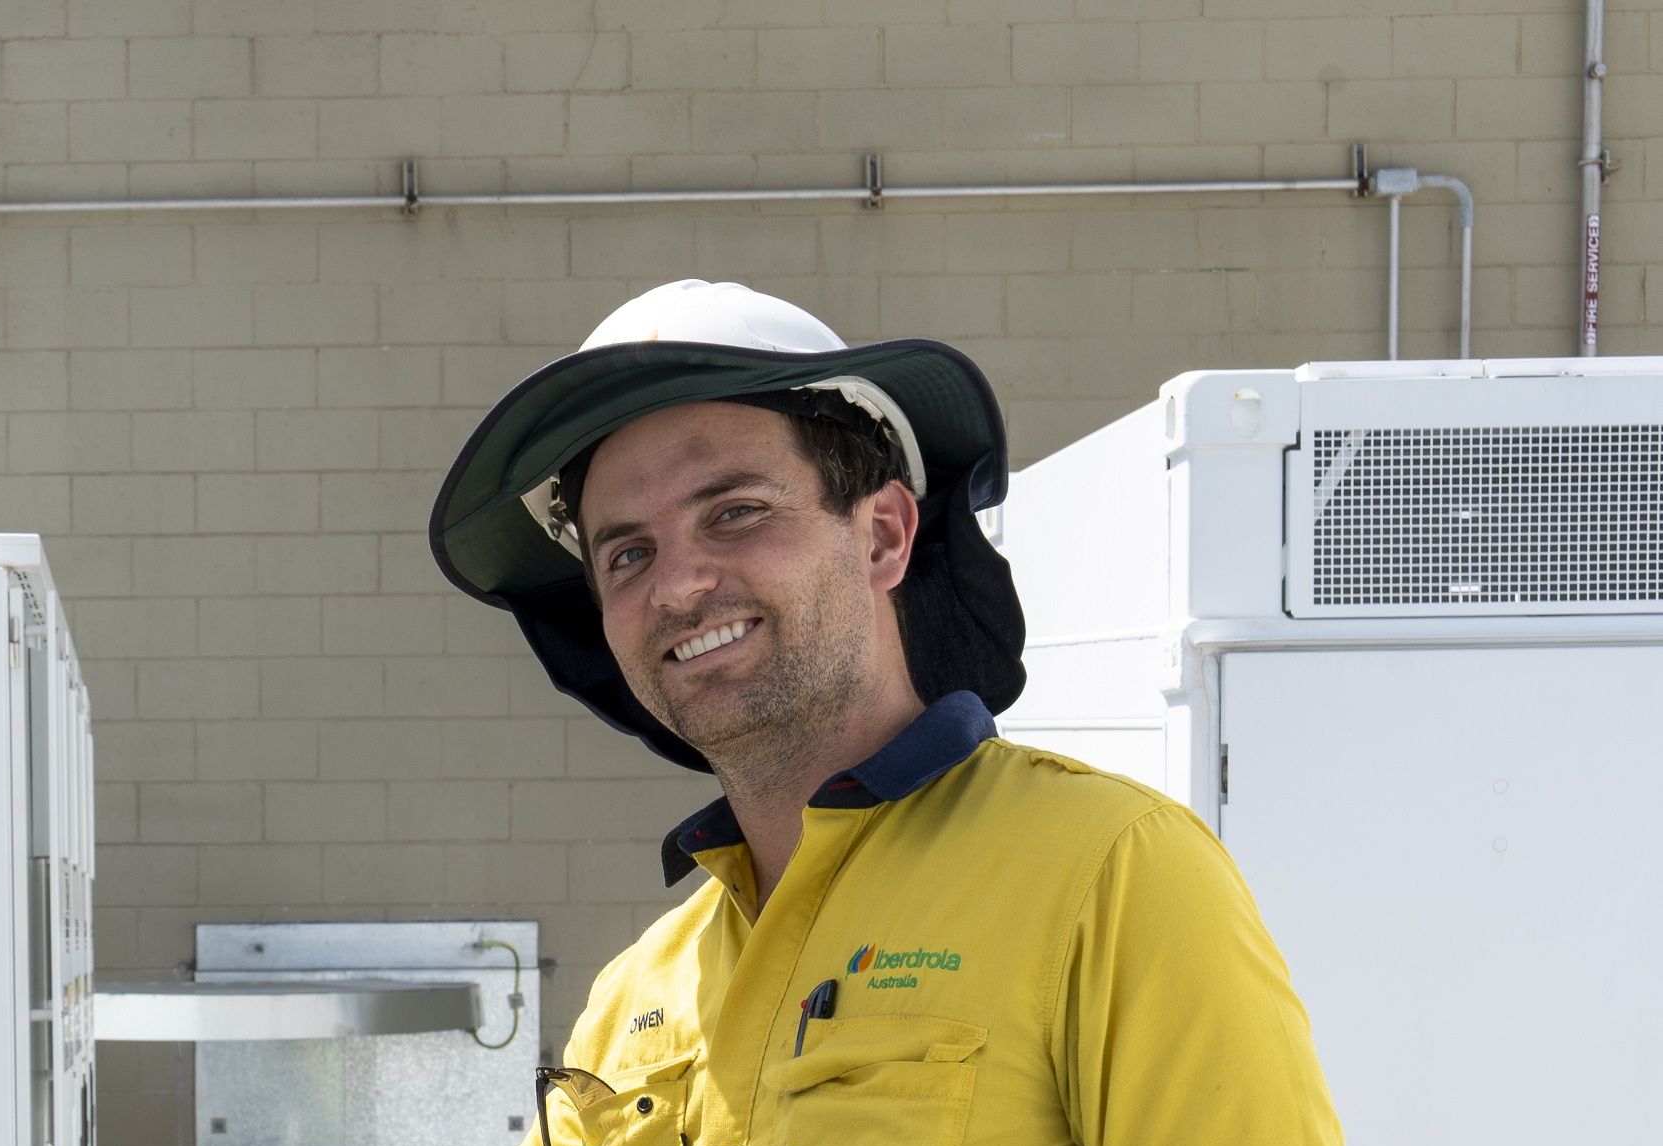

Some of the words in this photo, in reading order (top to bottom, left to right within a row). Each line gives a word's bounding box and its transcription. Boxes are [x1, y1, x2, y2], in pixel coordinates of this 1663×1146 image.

[1587, 226, 1600, 293] SERVICE
[1586, 298, 1598, 330] FIRE
[873, 948, 962, 971] Iberdrola
[866, 974, 918, 990] Australia
